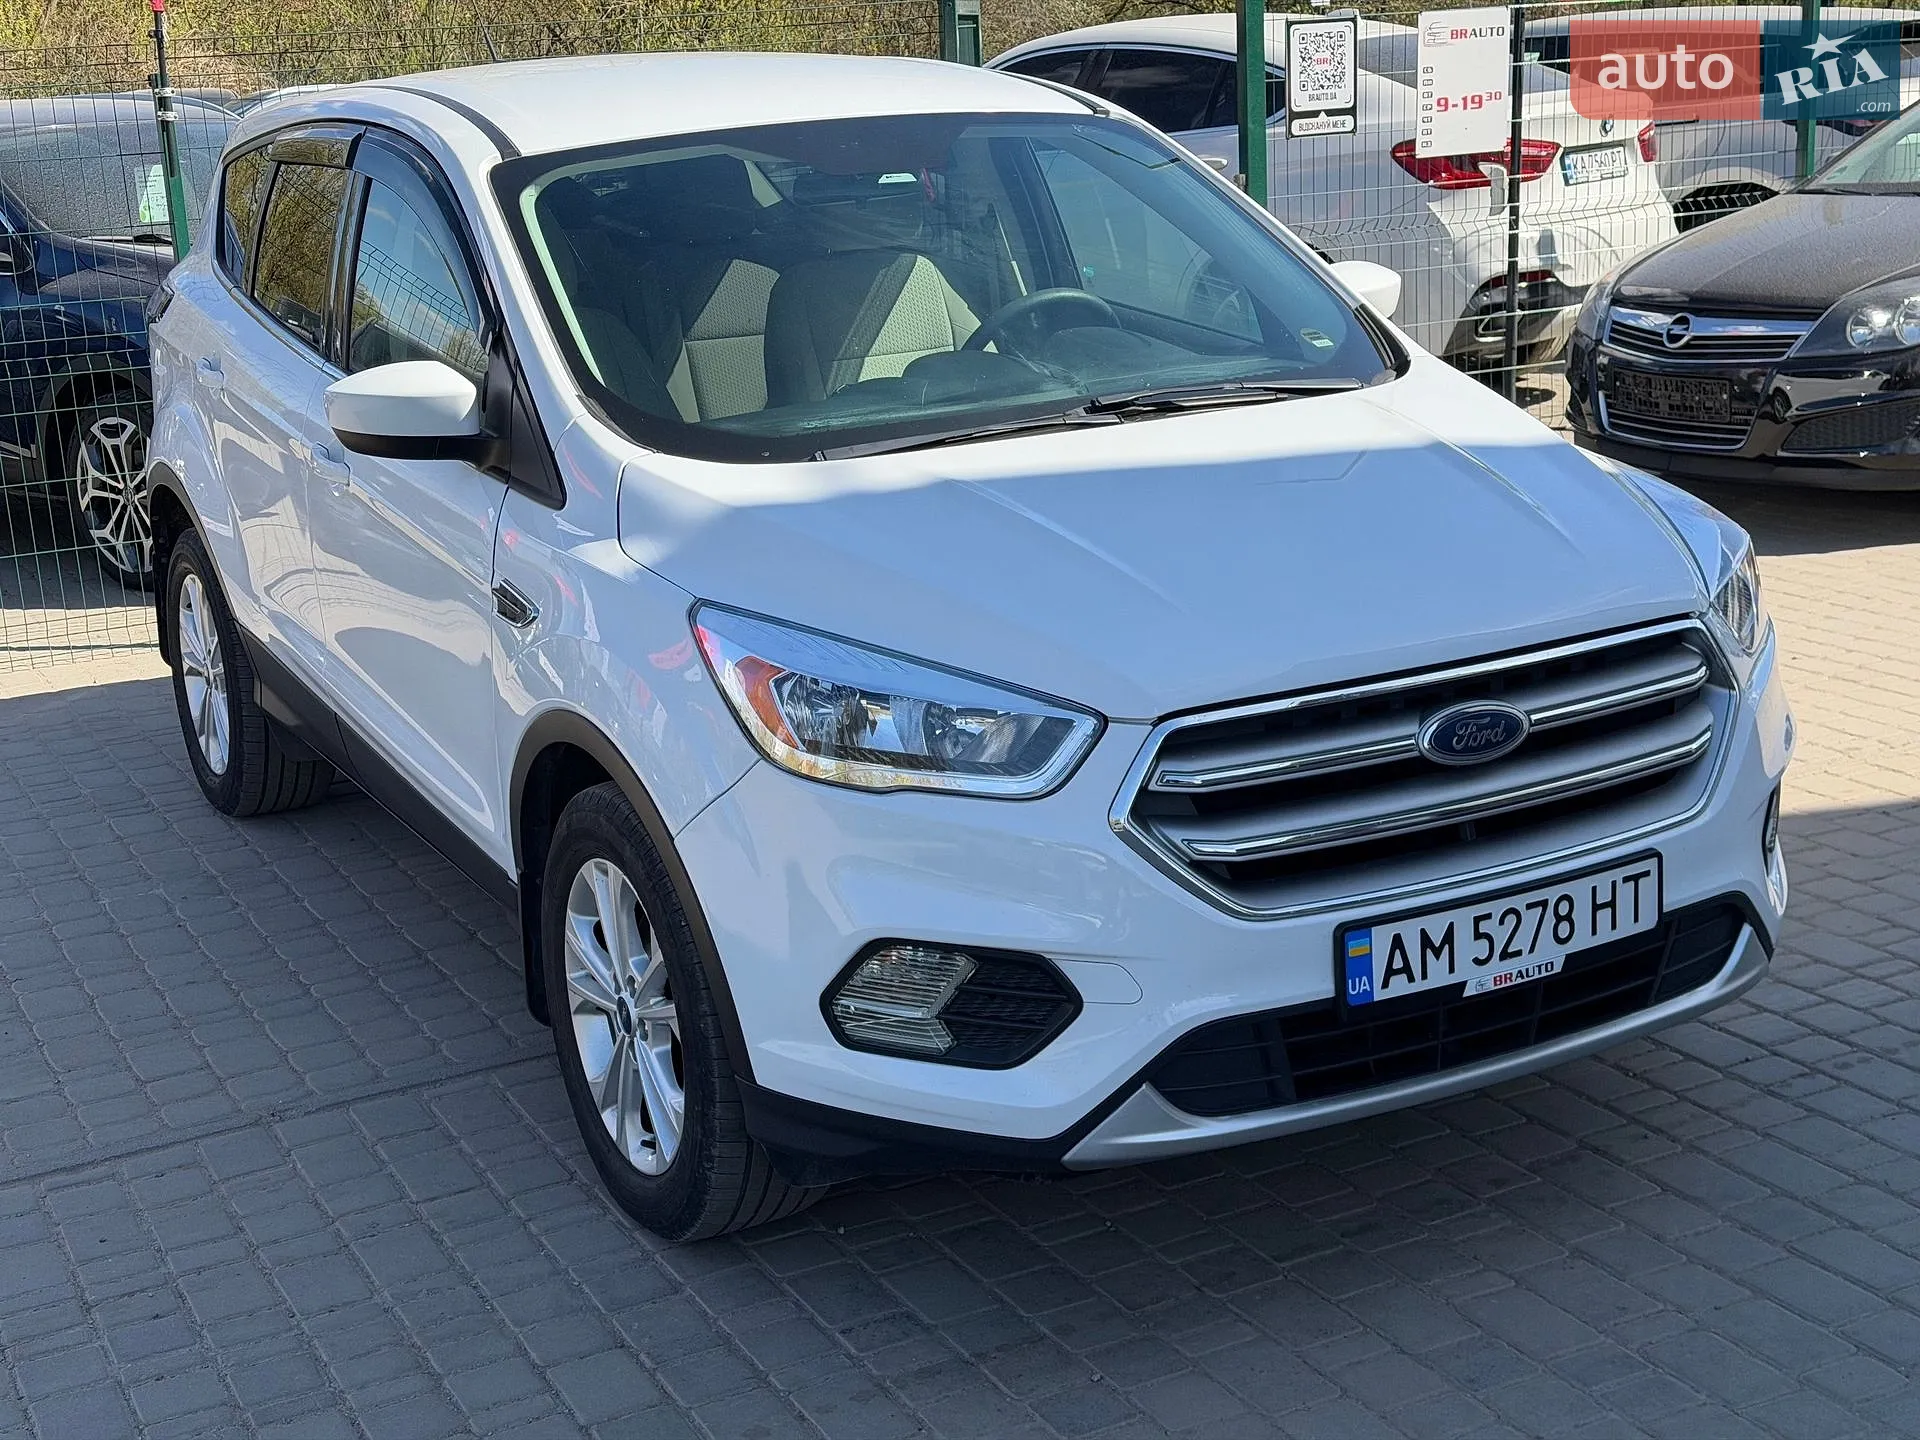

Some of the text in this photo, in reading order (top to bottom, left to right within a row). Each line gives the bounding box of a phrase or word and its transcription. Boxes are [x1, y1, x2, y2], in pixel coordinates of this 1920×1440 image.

[1450, 26, 1505, 40] BRAUTO
[1332, 119, 1347, 129] МЕНЕ
[1452, 716, 1506, 750] Ford
[1381, 869, 1651, 990] AM 5278 HT
[1493, 961, 1555, 987] BRAUTO
[1348, 976, 1371, 995] UA
